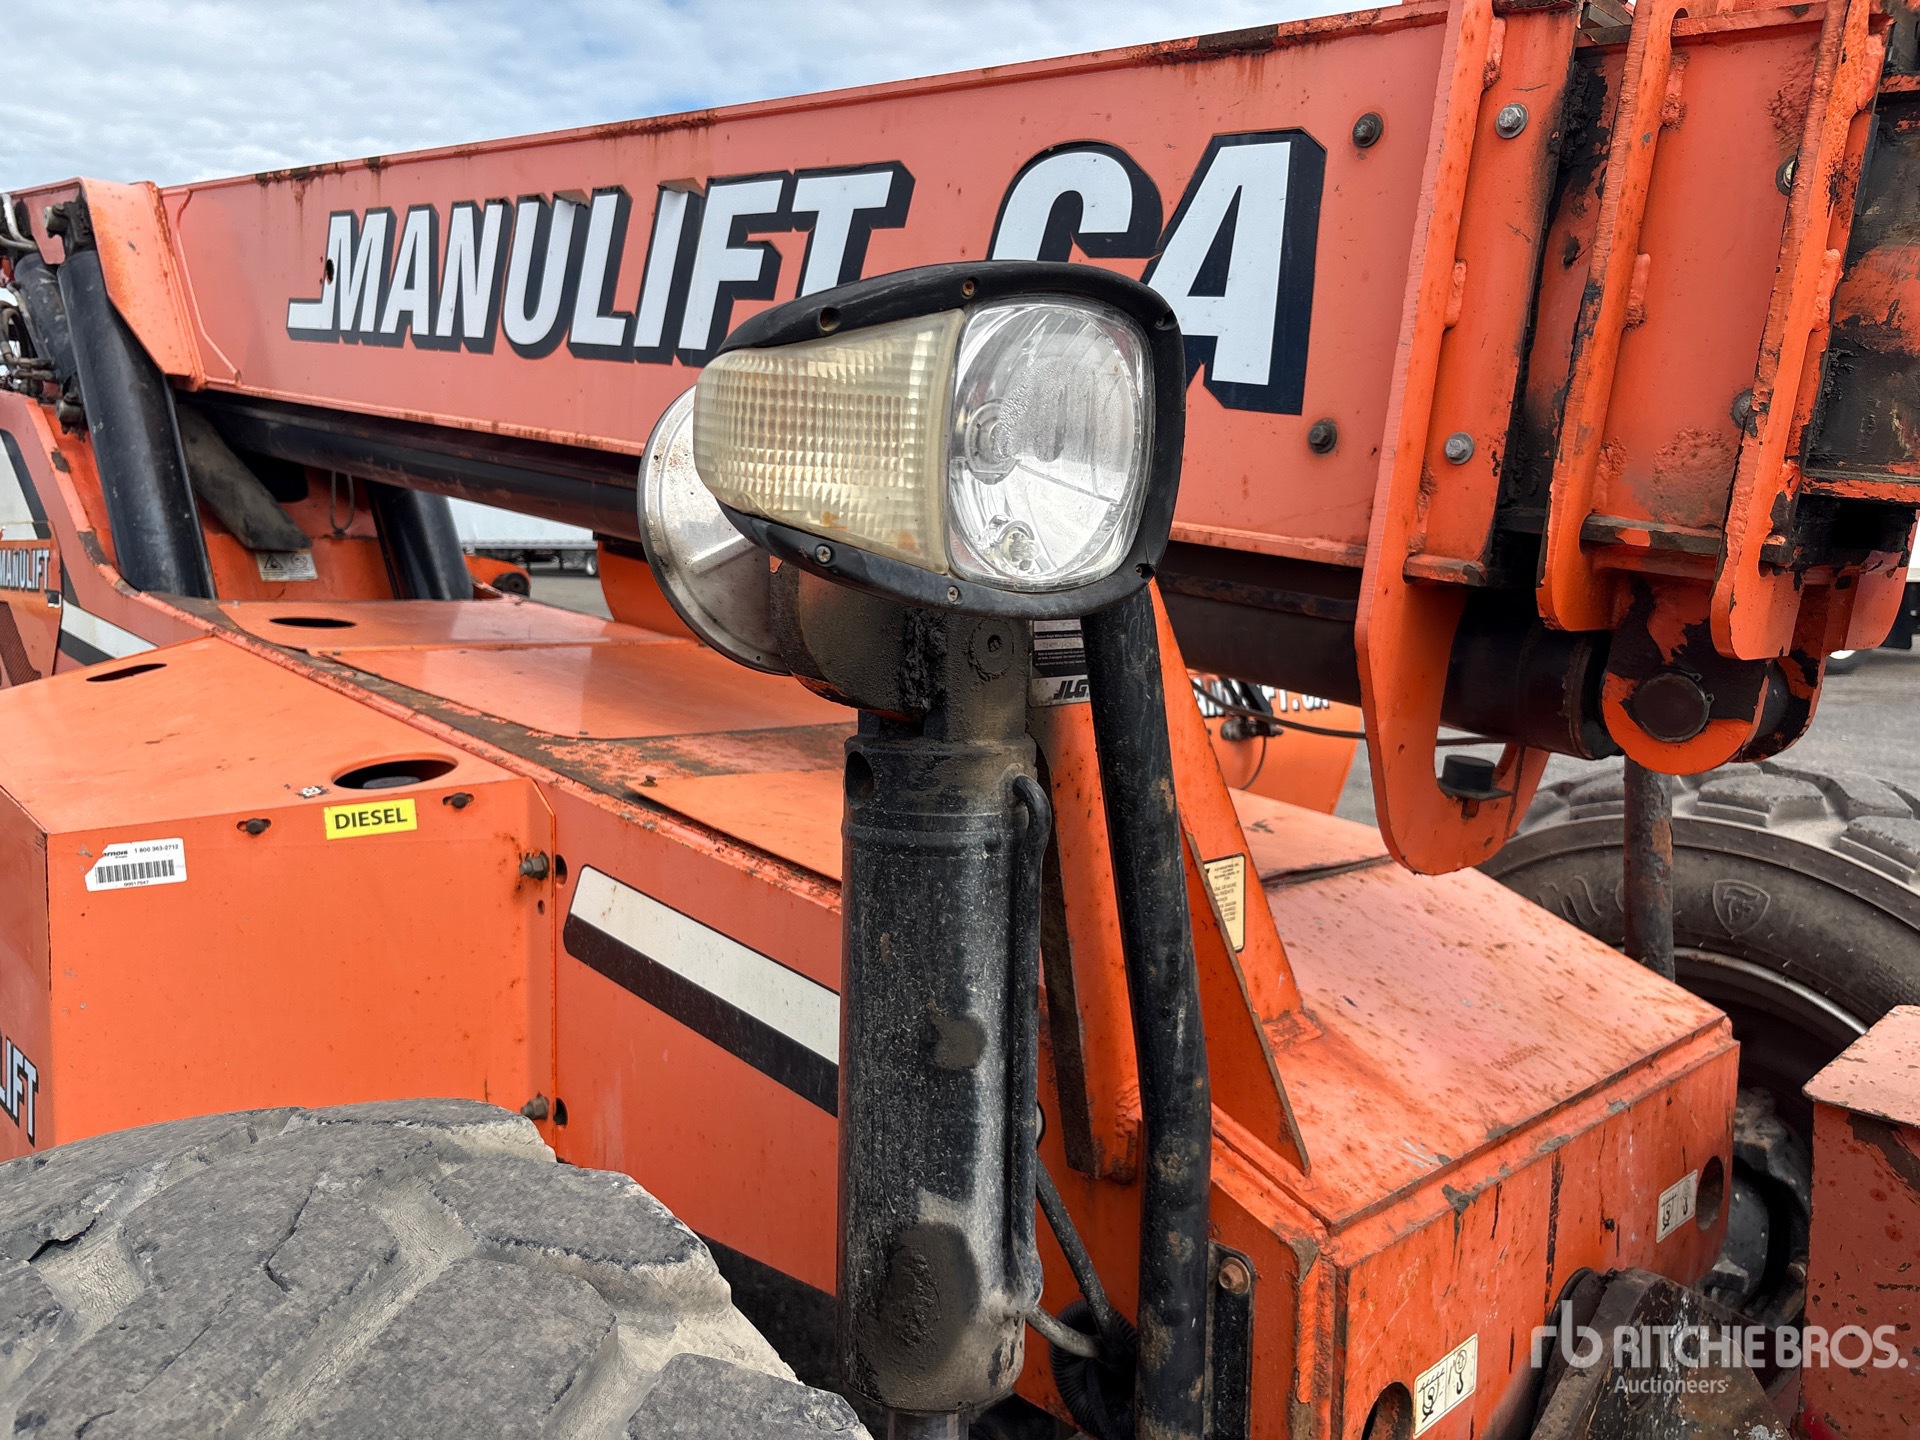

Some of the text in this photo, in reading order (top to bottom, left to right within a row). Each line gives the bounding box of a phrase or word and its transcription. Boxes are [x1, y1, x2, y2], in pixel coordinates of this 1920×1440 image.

[287, 161, 915, 366] MANULIFT
[1053, 680, 1089, 700] JLG
[334, 807, 408, 830] DIESEL
